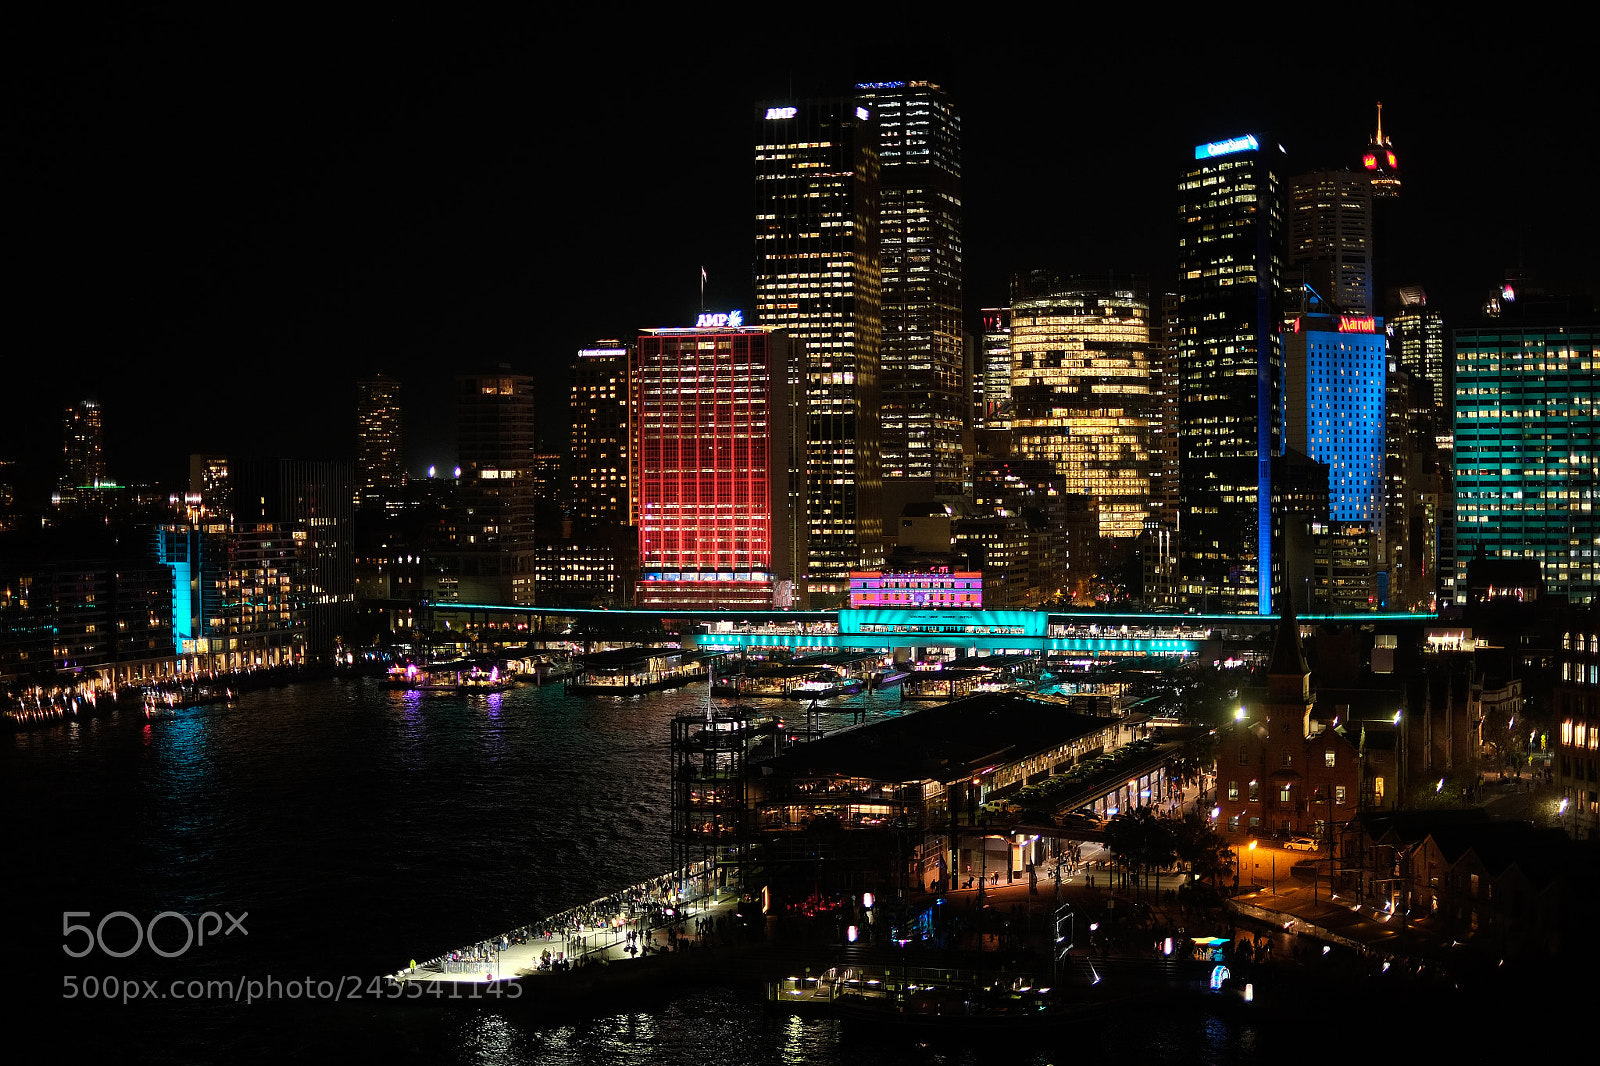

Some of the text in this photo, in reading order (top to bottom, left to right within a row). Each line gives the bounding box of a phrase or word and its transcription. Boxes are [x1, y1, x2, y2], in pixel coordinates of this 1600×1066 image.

[765, 106, 798, 120] AMP
[695, 313, 728, 327] AMP
[1338, 315, 1375, 333] Marriott
